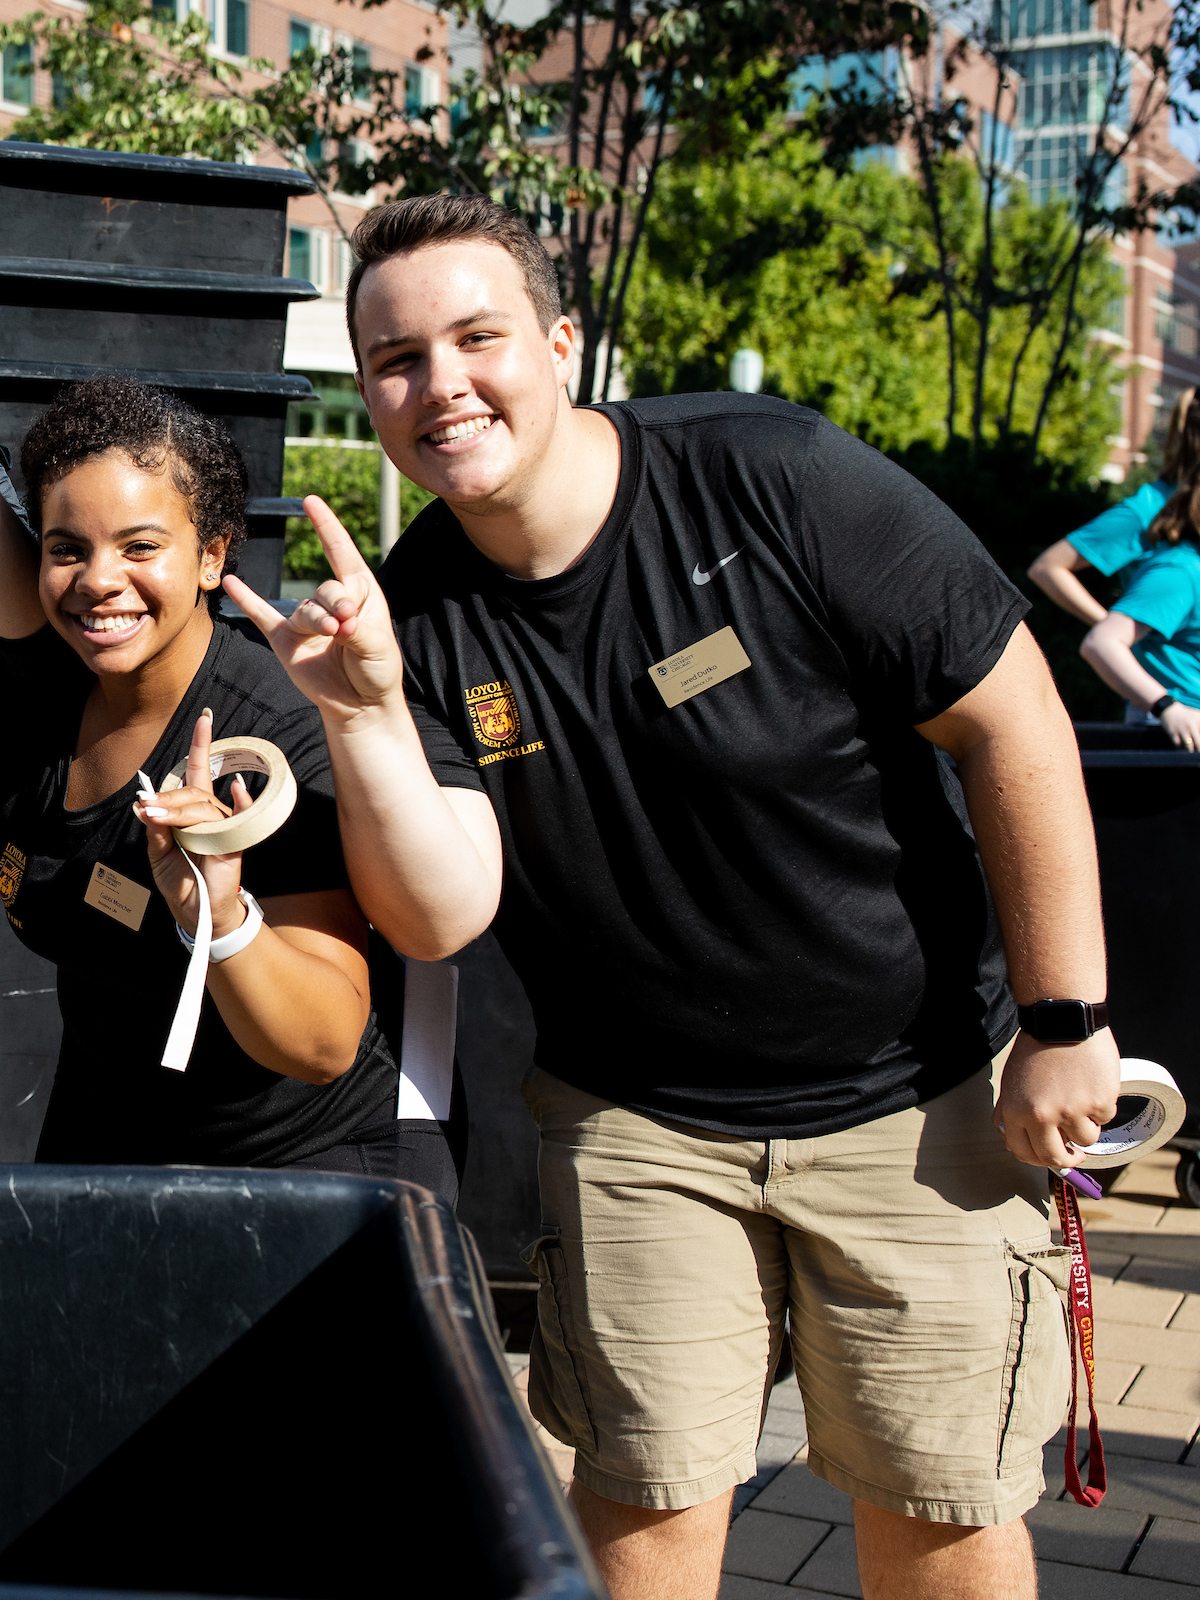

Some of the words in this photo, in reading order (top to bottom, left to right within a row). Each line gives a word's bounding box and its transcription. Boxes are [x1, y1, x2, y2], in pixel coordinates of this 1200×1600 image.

[668, 655, 684, 666] LOYOLA
[671, 660, 692, 673] CHICAGO
[680, 673, 698, 688] Jared
[696, 664, 718, 678] Dutko
[464, 680, 511, 700] LOYOLA
[683, 680, 705, 694] Residence
[466, 693, 494, 705] UNIVERSITY
[468, 705, 477, 719] AD
[480, 708, 496, 718] 1870
[472, 721, 502, 749] MAJOREM
[477, 747, 520, 767] SIDENCE
[520, 740, 546, 755] LIFE
[5, 842, 27, 866] LOYOLA
[100, 891, 113, 903] Gabbi
[1067, 1196, 1090, 1309] UNIVERSITY
